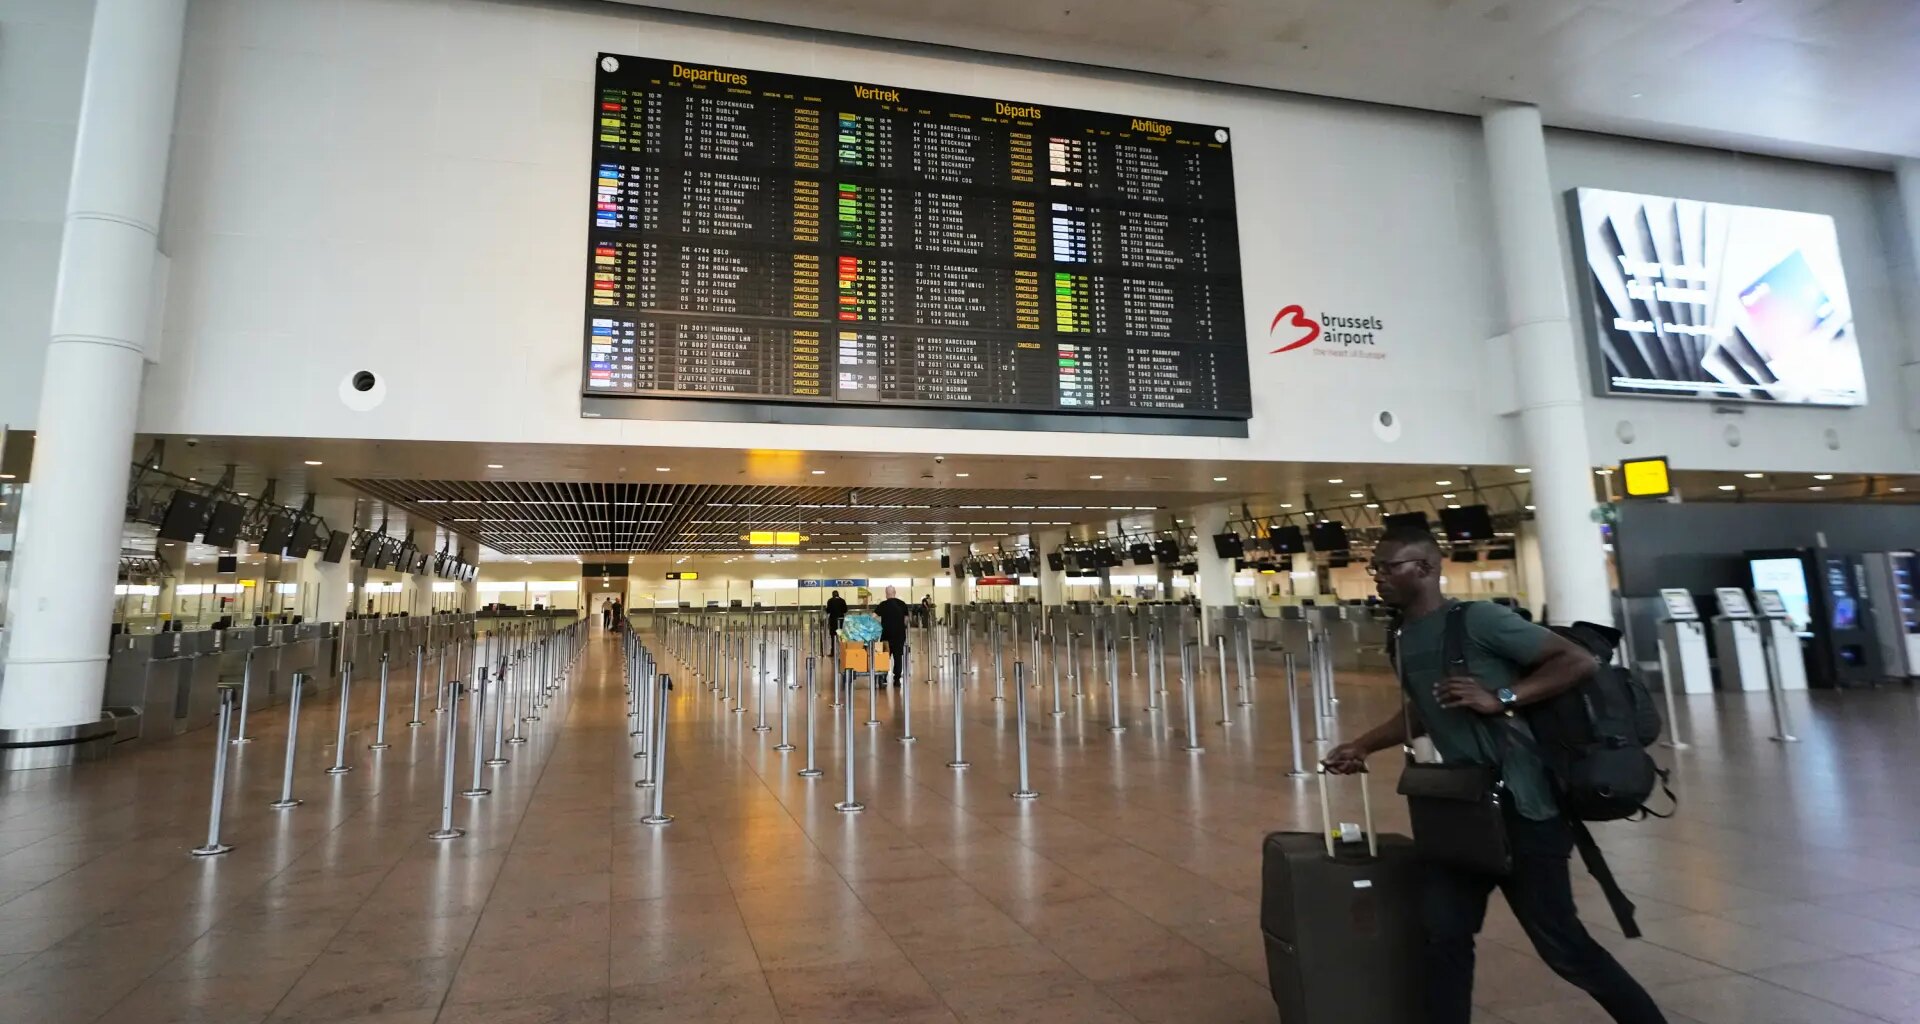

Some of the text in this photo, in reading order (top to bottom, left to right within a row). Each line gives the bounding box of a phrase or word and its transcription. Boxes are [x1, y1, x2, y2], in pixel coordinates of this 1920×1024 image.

[672, 64, 748, 85] Departures
[854, 85, 900, 103] Vertrek
[716, 100, 754, 109] COPENHAGEN
[995, 102, 1041, 119] Départs
[1131, 119, 1173, 136] Abflüge
[941, 154, 975, 162] COPENHAGEN
[716, 174, 760, 182] THESSALONIKI
[714, 189, 744, 197] FLORENCE
[714, 221, 752, 229] WASHINGTON
[1321, 312, 1383, 330] brussels
[1324, 328, 1374, 347] airport
